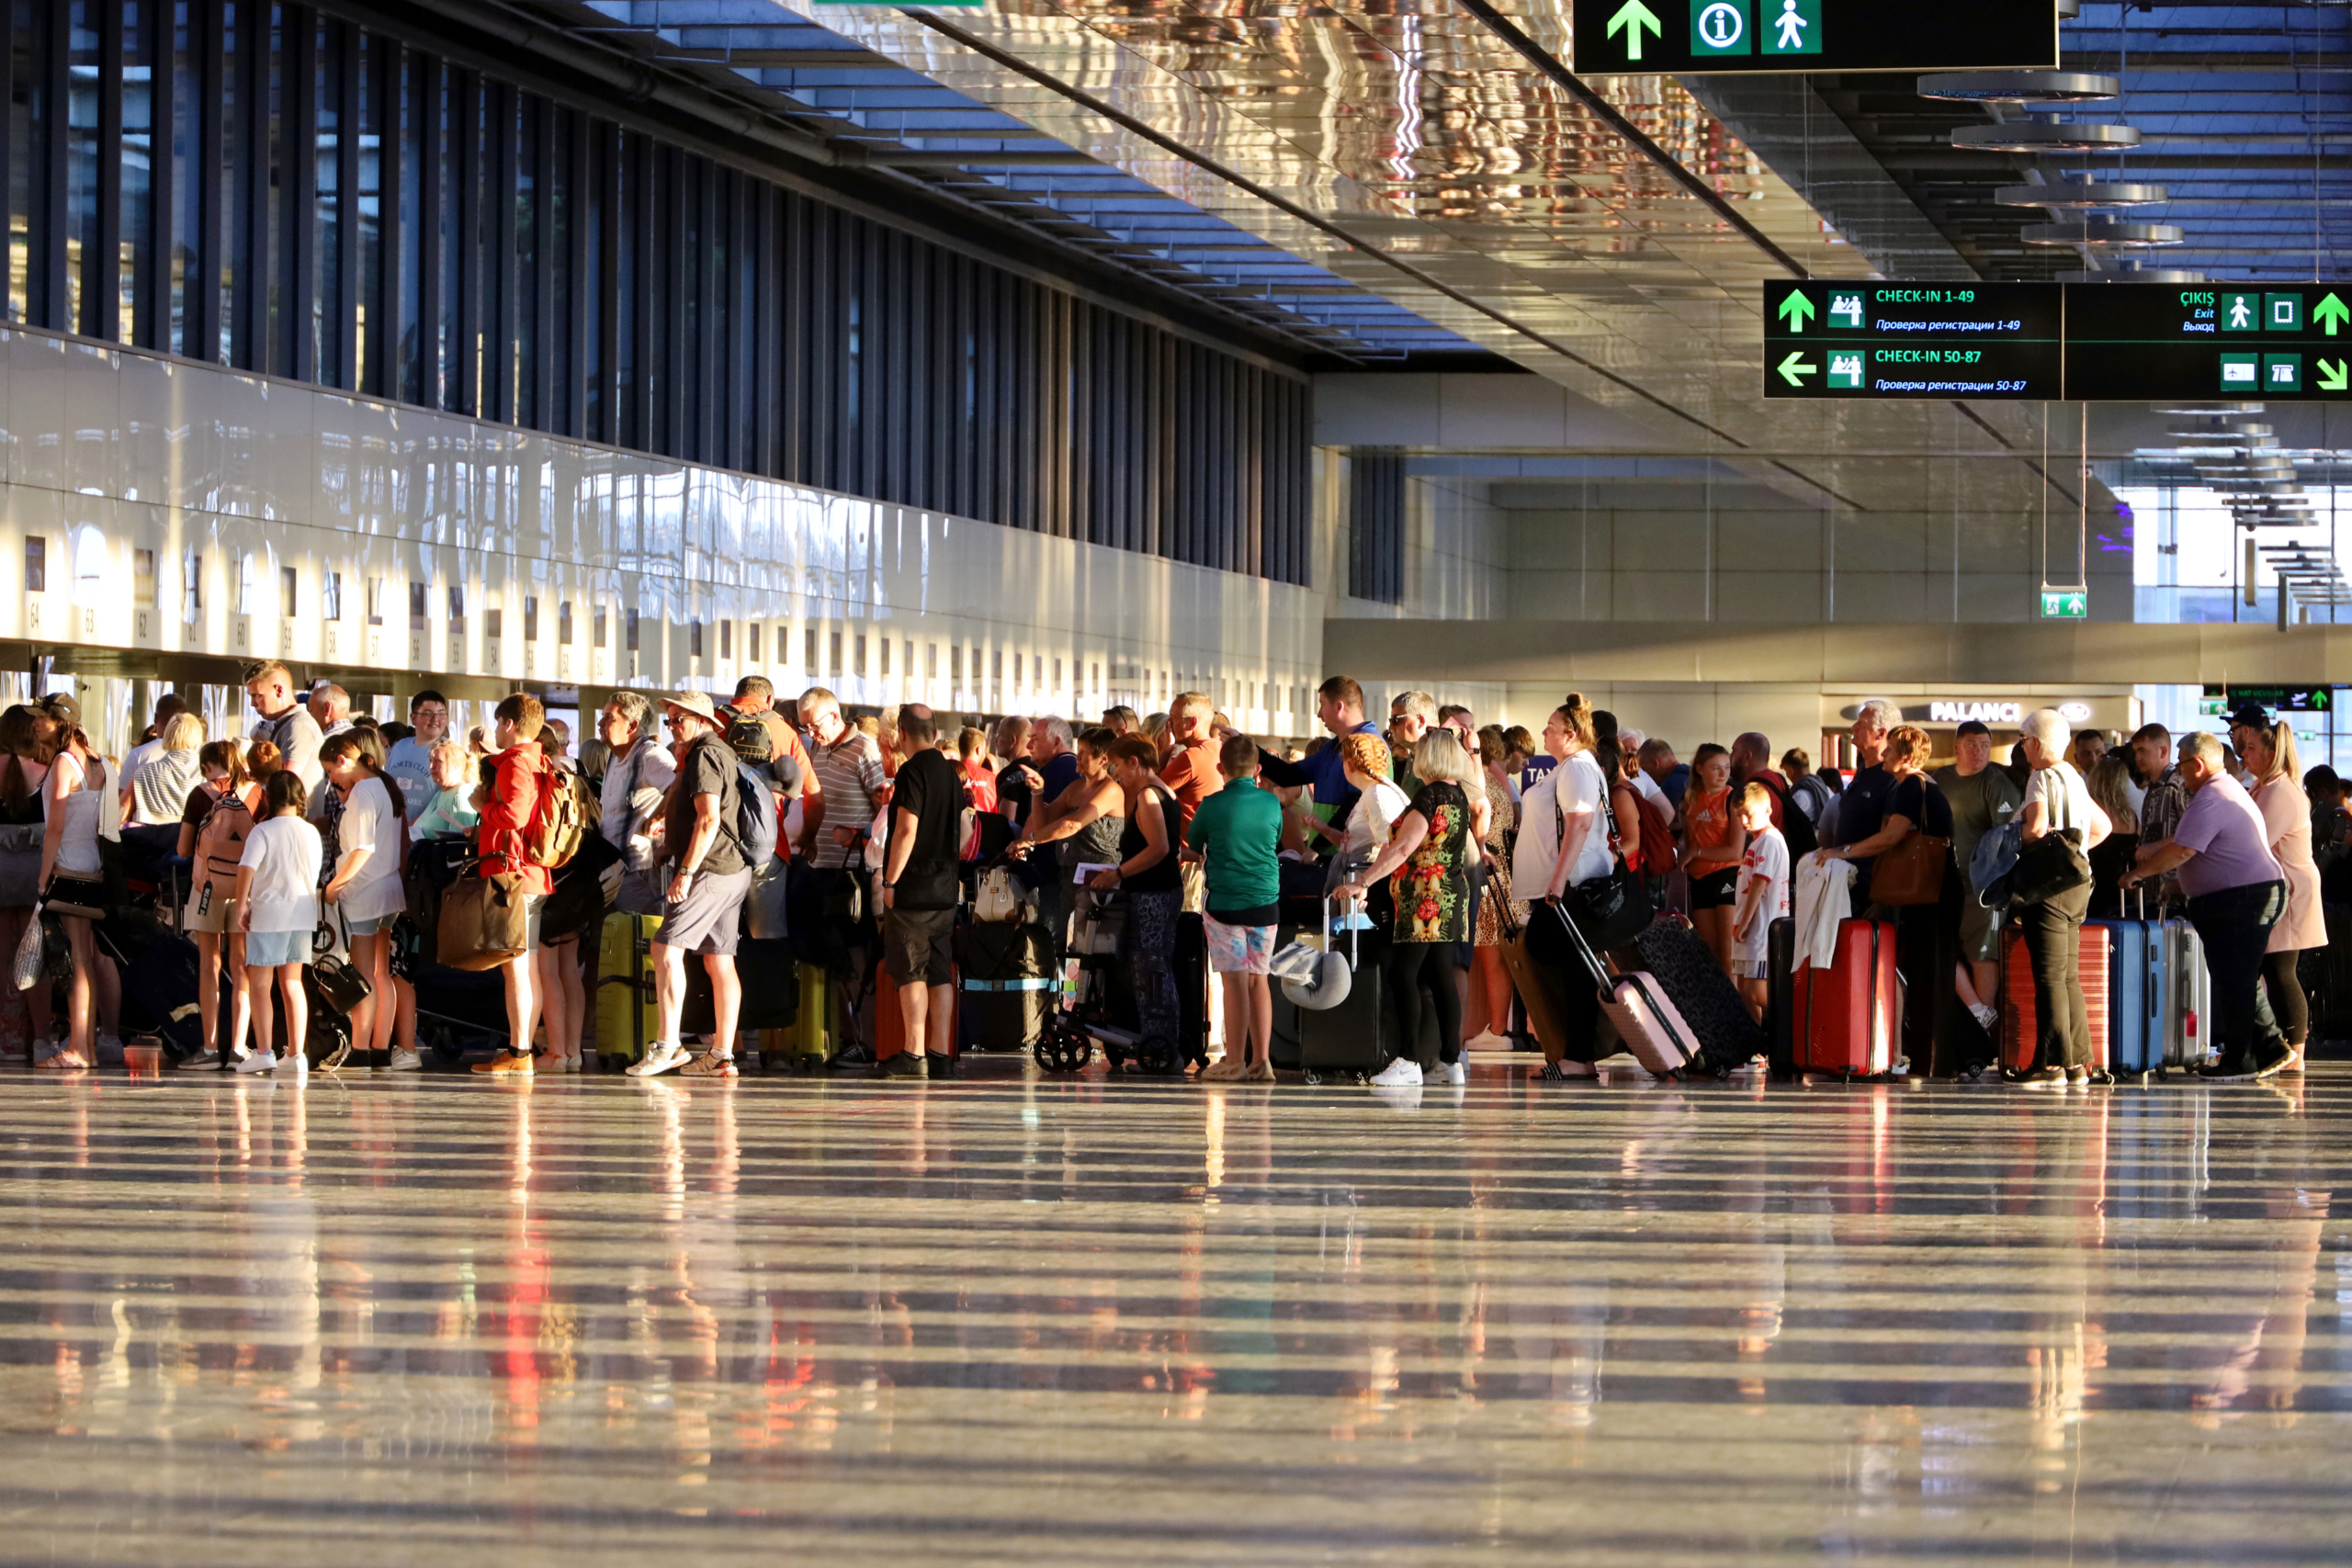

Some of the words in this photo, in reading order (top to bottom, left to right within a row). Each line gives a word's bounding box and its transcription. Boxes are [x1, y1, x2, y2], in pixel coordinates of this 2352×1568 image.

[1875, 289, 1941, 302] CHECK-IN
[1945, 290, 1974, 303] 1-49
[2180, 291, 2215, 307] ÇIKIŞ
[2194, 308, 2215, 319] Exit
[1875, 319, 1927, 332] Проверка
[1928, 321, 1995, 333] регистрации
[1996, 320, 2021, 331] 1-49
[2183, 321, 2215, 333] Выход
[1875, 350, 1940, 363] CHECK-IN
[1944, 350, 1982, 363] 50-87
[1875, 378, 1926, 391] Проверка
[1928, 381, 1994, 392] регистрации
[1996, 380, 2027, 391] 50-87
[30, 603, 40, 628] 64
[85, 608, 94, 633] 63
[139, 613, 147, 637] 62
[237, 622, 245, 647] 60
[284, 626, 292, 649] 59
[329, 631, 336, 653] 58
[371, 635, 379, 657] 57
[413, 638, 420, 660] 56
[453, 642, 459, 664] 55
[491, 646, 497, 667] 54
[1930, 702, 2020, 722] PALANCI
[413, 762, 431, 778] CLUB
[1527, 767, 1551, 783] TA
